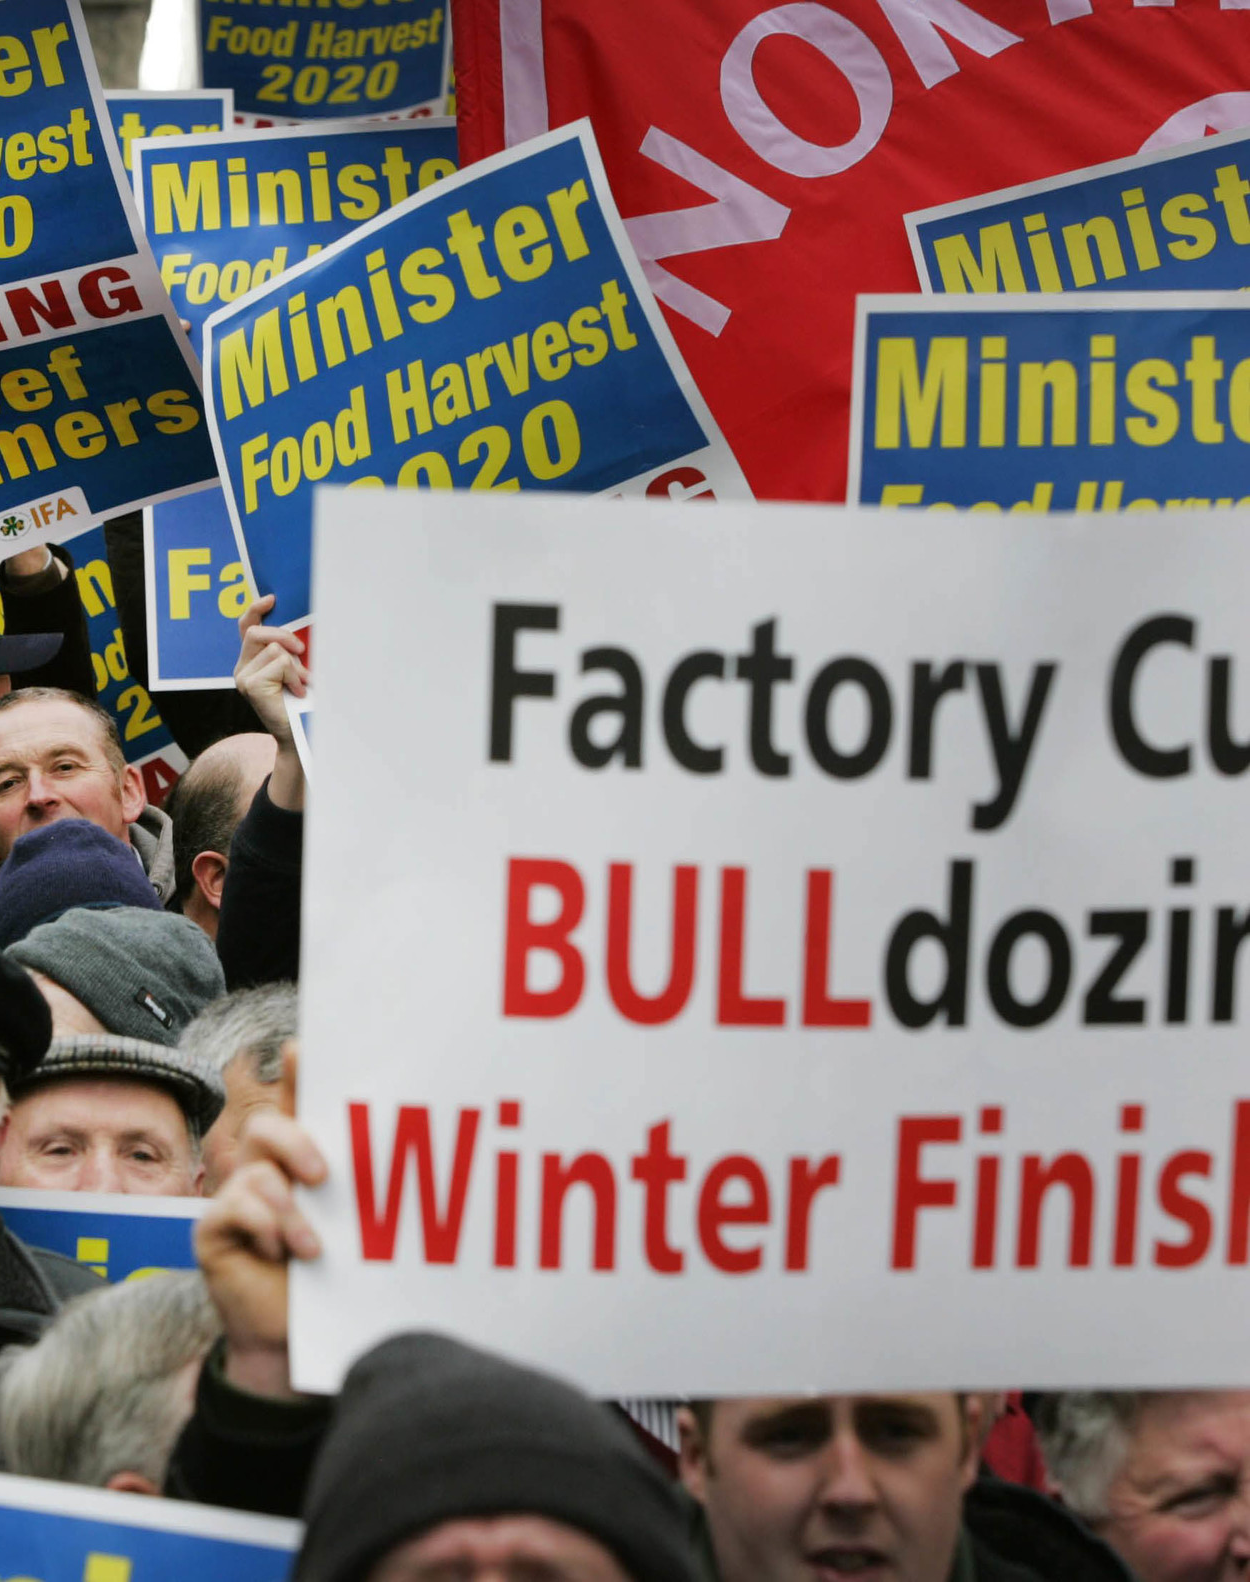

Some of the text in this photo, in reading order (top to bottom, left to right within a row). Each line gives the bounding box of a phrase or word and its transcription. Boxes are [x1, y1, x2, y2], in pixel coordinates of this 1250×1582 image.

[206, 8, 444, 59] Food Harvest
[256, 60, 399, 105] 2020
[159, 246, 288, 304] Food
[218, 179, 591, 422] Minister
[240, 279, 639, 514] Food Harvest
[30, 498, 78, 528] IFA
[487, 601, 1059, 831] Factory
[347, 1100, 841, 1275] Winter
